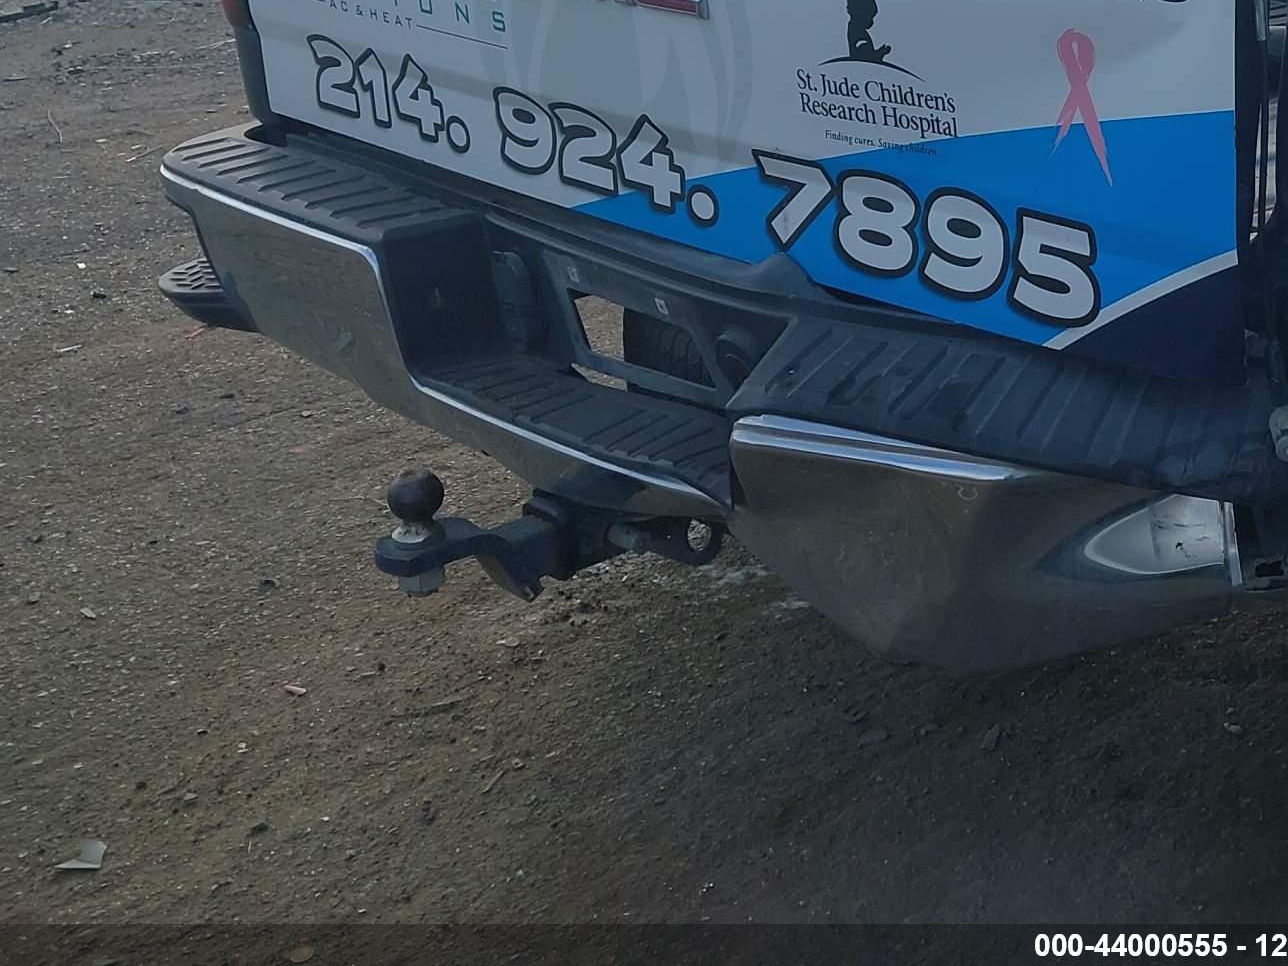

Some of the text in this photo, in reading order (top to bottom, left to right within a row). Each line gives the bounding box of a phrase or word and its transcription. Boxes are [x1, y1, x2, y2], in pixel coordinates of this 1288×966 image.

[796, 68, 956, 114] St. Jude Children's
[800, 92, 960, 139] Research Hospital
[825, 129, 853, 145] Finding
[854, 137, 876, 147] cures.
[877, 137, 904, 153] Saving
[306, 33, 1101, 328] 214. 924. 7895
